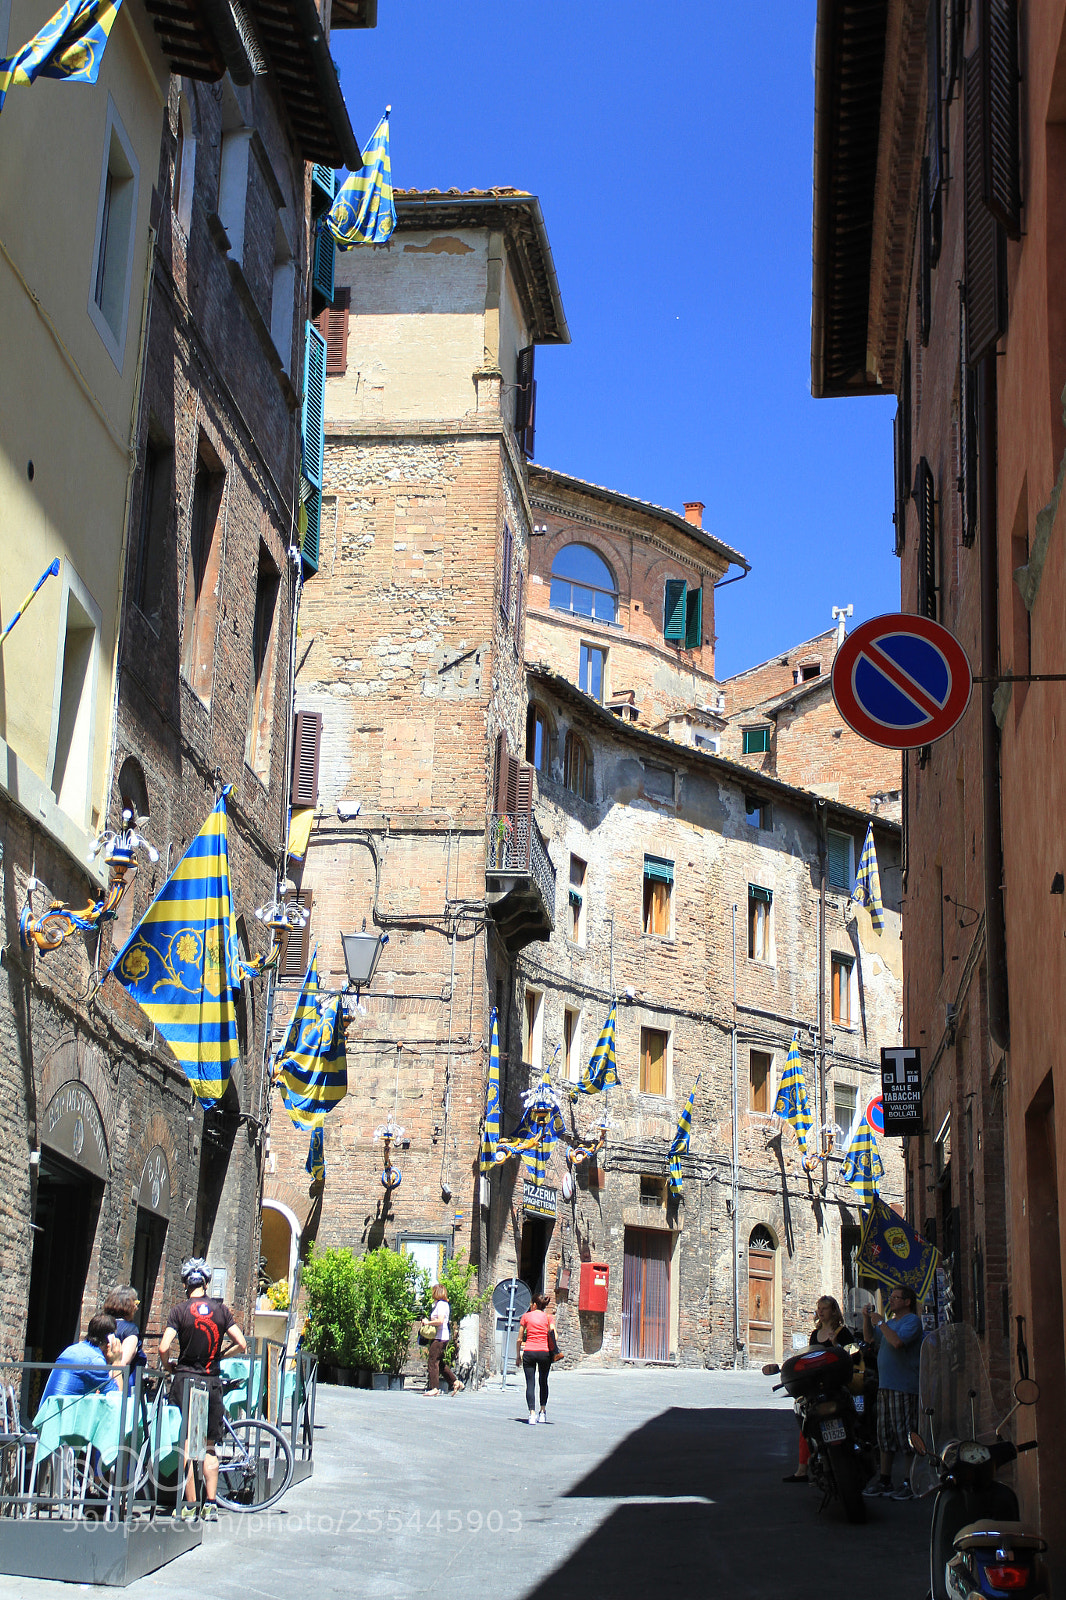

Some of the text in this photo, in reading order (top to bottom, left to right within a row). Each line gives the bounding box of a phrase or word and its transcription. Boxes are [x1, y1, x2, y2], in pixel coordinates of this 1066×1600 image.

[884, 1049, 916, 1083] T
[891, 1084, 906, 1092] SALI
[883, 1091, 920, 1102] TABACCHI
[888, 1110, 917, 1118] BOLLATI
[523, 1183, 556, 1203] PIZZERIA
[522, 1195, 556, 1211] SPAGHETTERIA
